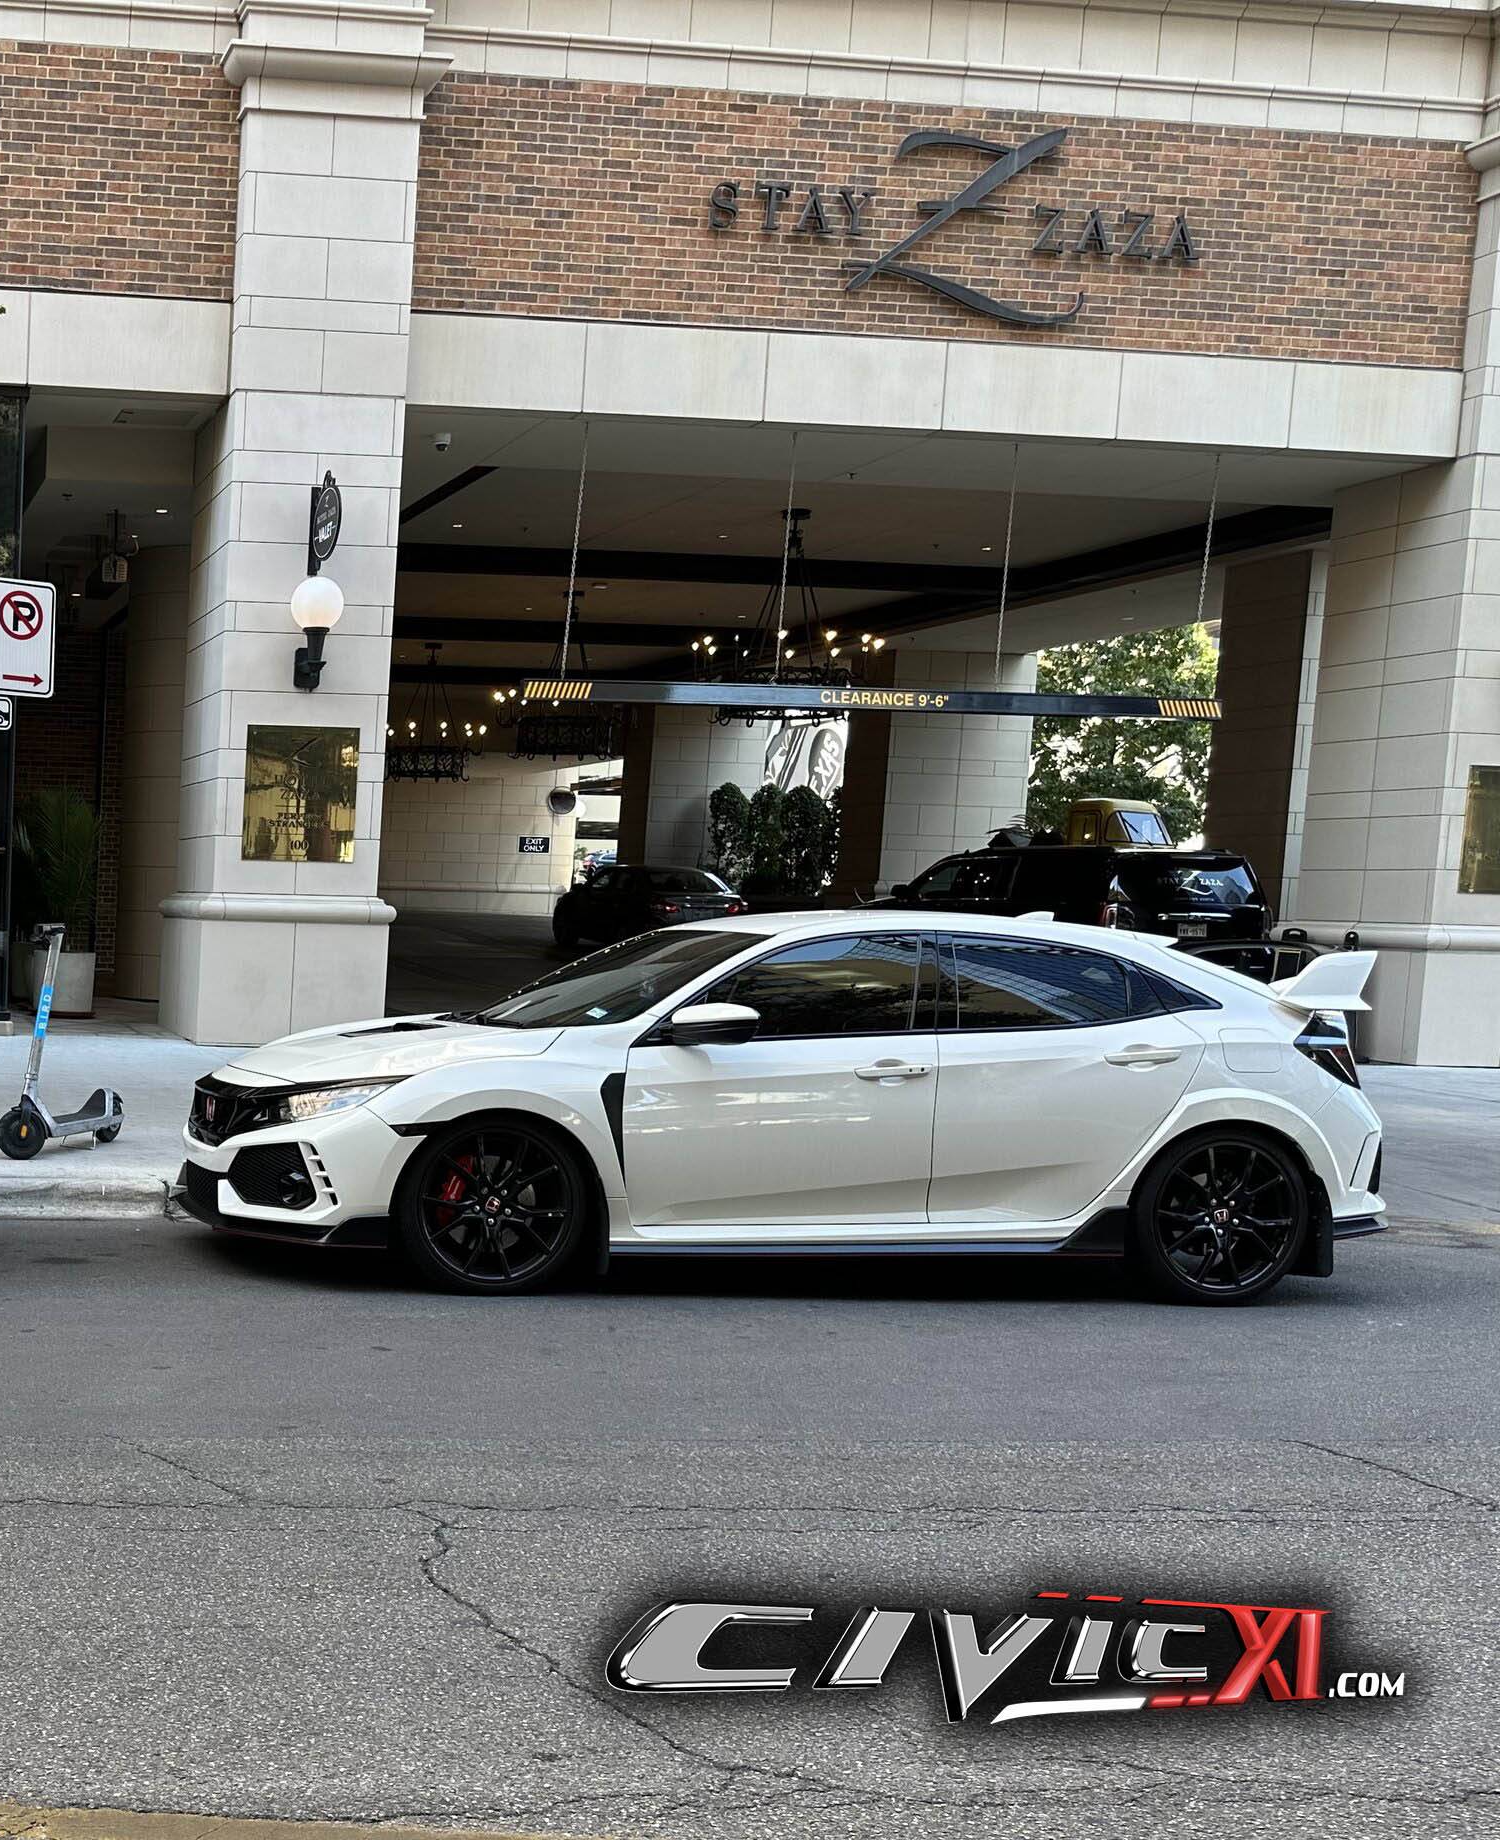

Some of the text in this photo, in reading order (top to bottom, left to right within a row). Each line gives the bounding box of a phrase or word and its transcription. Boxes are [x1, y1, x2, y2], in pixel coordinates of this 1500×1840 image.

[707, 180, 874, 236] STAY
[1032, 203, 1199, 260] ZAZA
[820, 690, 949, 708] CLEARANCE 9'-6"
[38, 994, 51, 1029] BIRD
